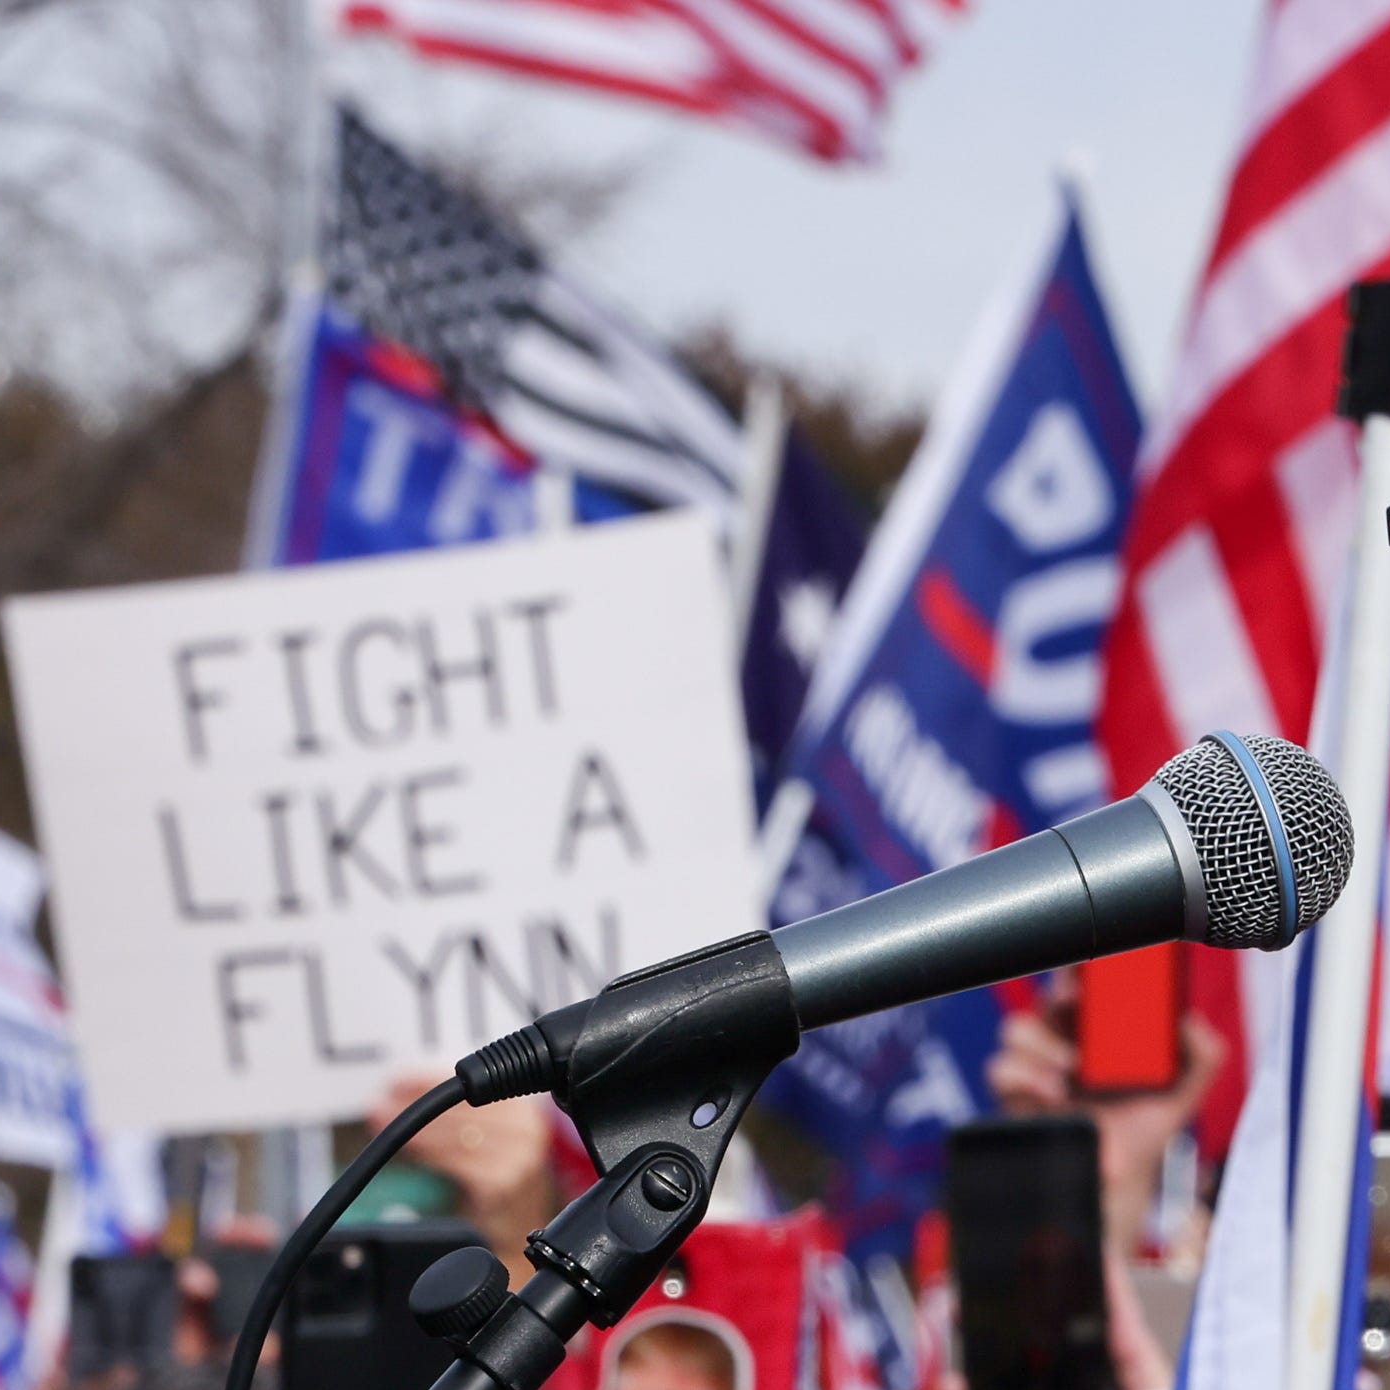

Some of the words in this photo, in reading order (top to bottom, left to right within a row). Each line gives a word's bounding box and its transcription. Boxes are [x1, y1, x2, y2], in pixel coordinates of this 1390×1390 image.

[171, 592, 565, 765] FIGHT
[158, 768, 486, 924] LIKE
[554, 750, 648, 877] A
